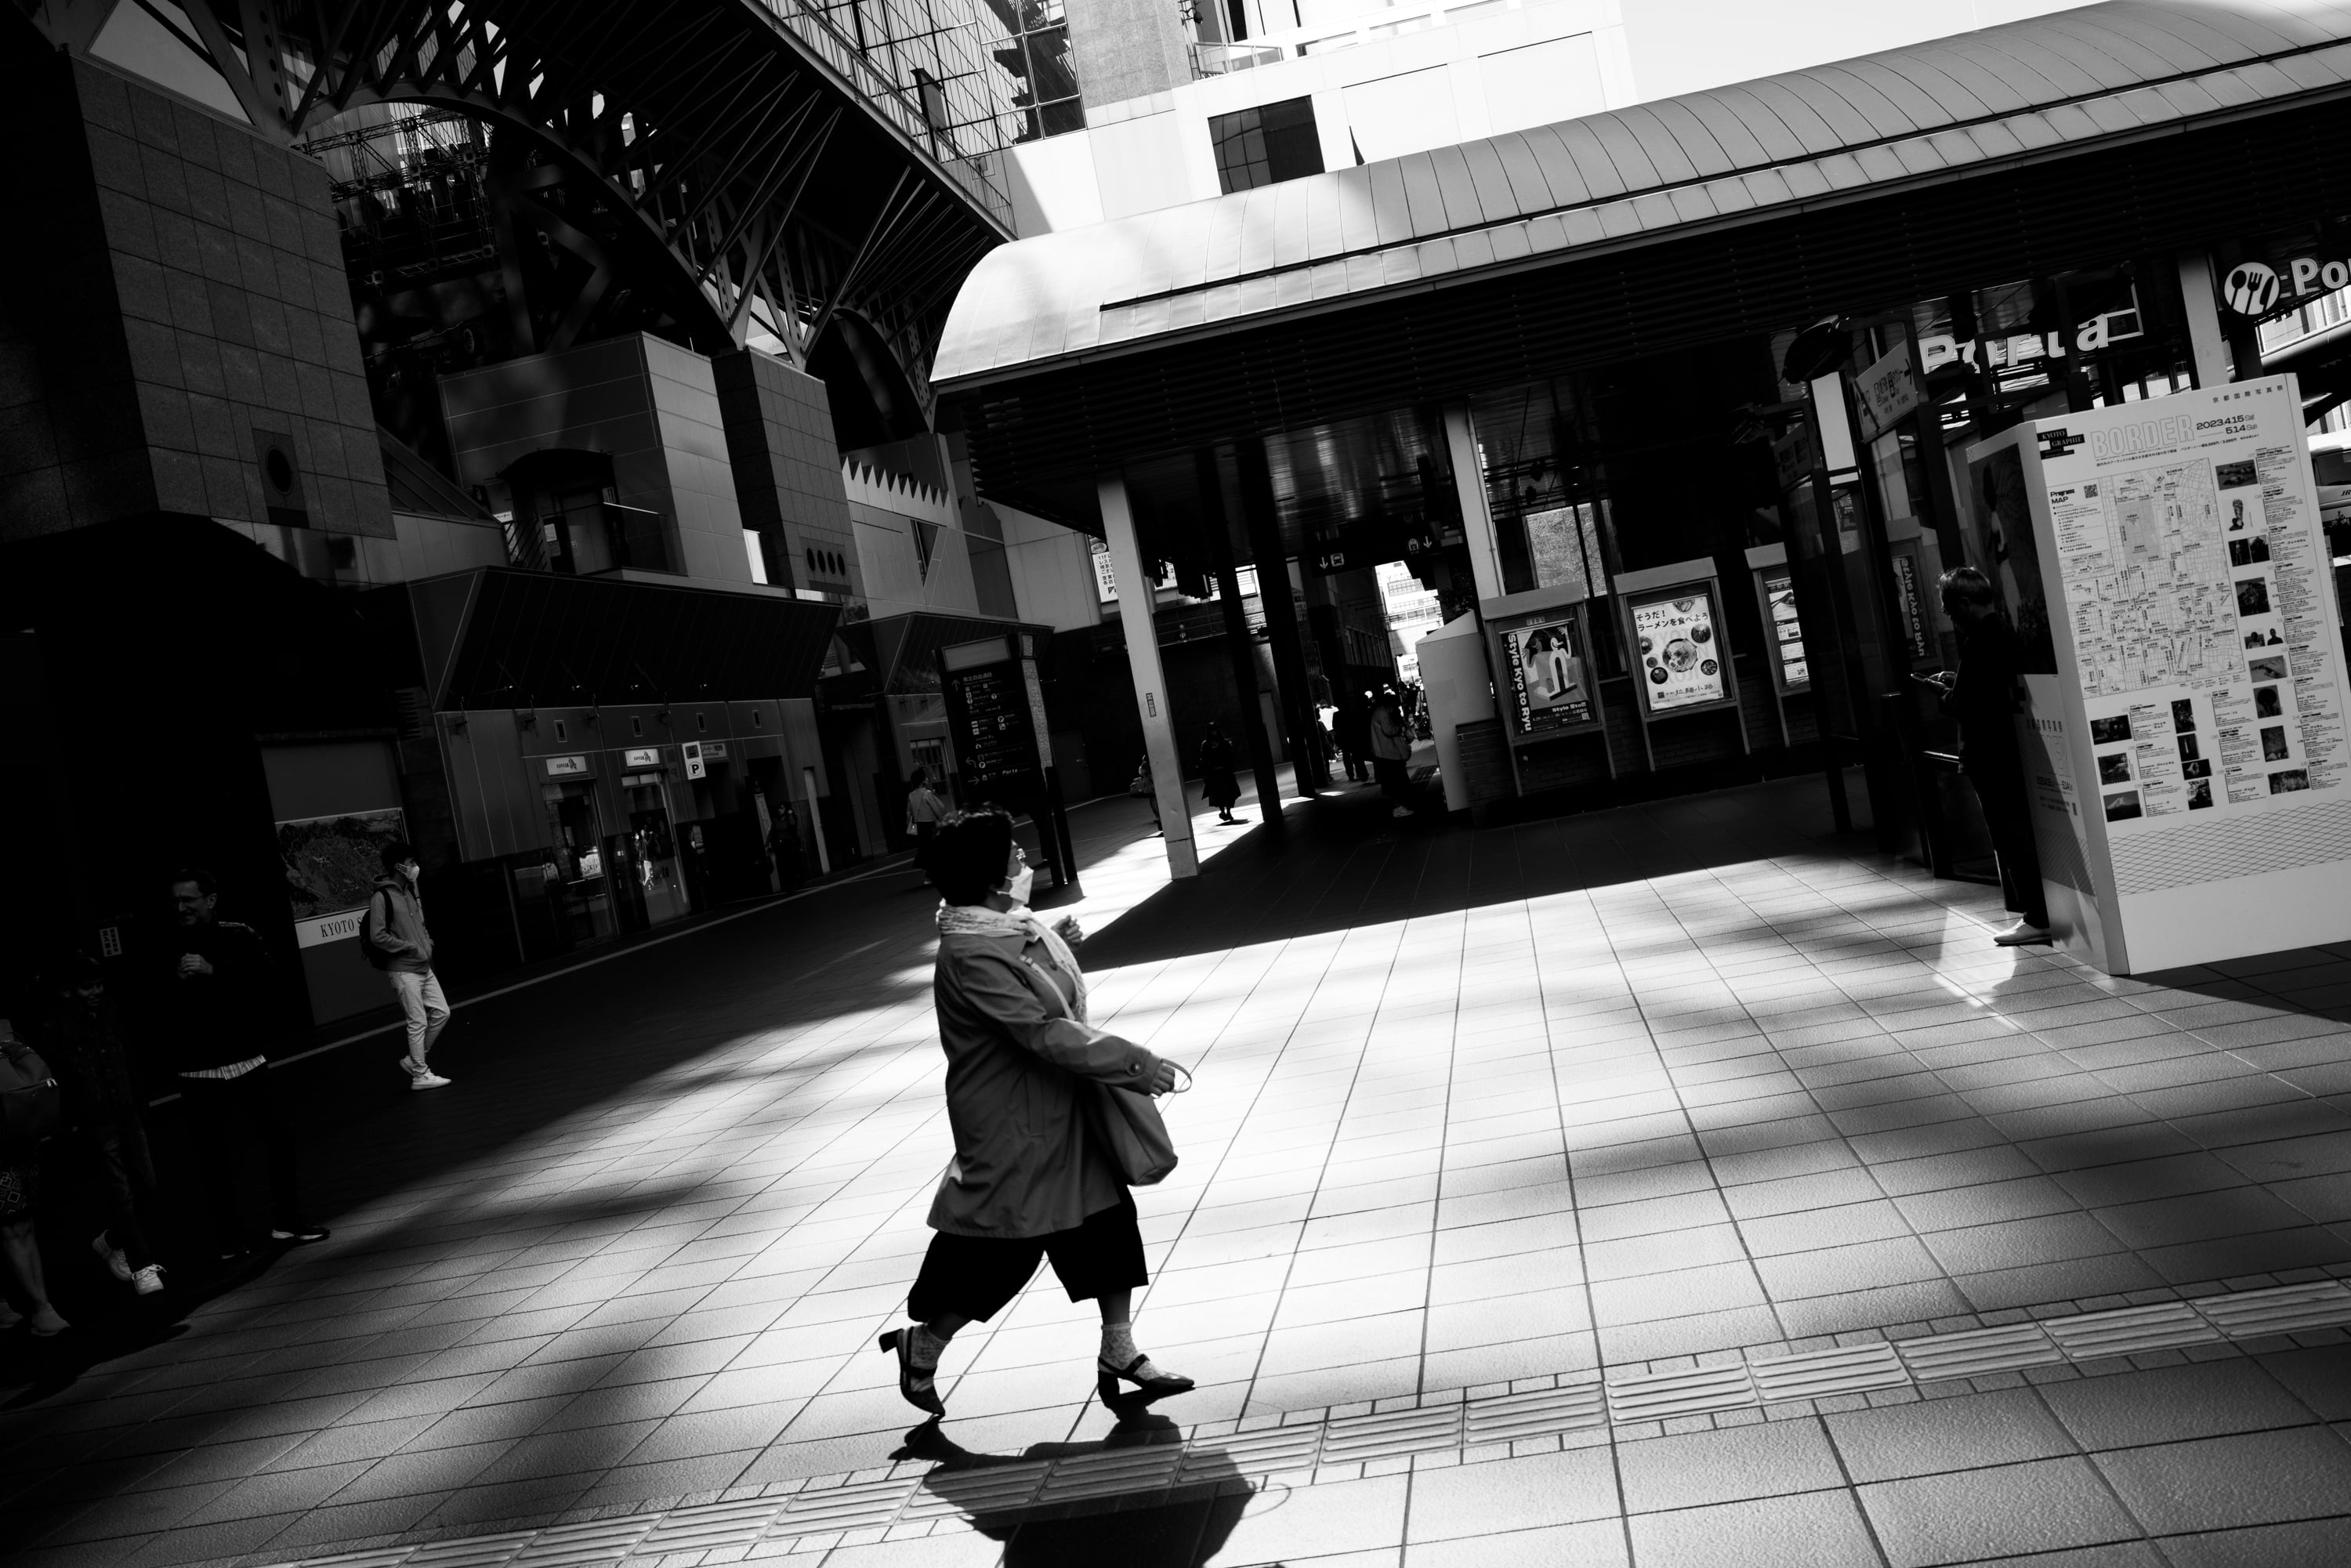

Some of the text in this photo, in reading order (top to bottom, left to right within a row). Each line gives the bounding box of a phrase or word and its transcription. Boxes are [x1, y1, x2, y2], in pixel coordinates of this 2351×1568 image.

[2291, 258, 2351, 296] Po
[2041, 430, 2064, 440] KYOTO
[2052, 436, 2083, 447] GRAPHIE
[2089, 414, 2195, 458] BORDER
[1638, 613, 1708, 632] ラーメンを食べよう
[1508, 634, 1520, 664] Style
[1514, 669, 1523, 690] Kyo
[1520, 693, 1527, 706] to
[1521, 707, 1531, 731] Ryu
[692, 764, 699, 773] P
[320, 919, 354, 937] KYOTO
